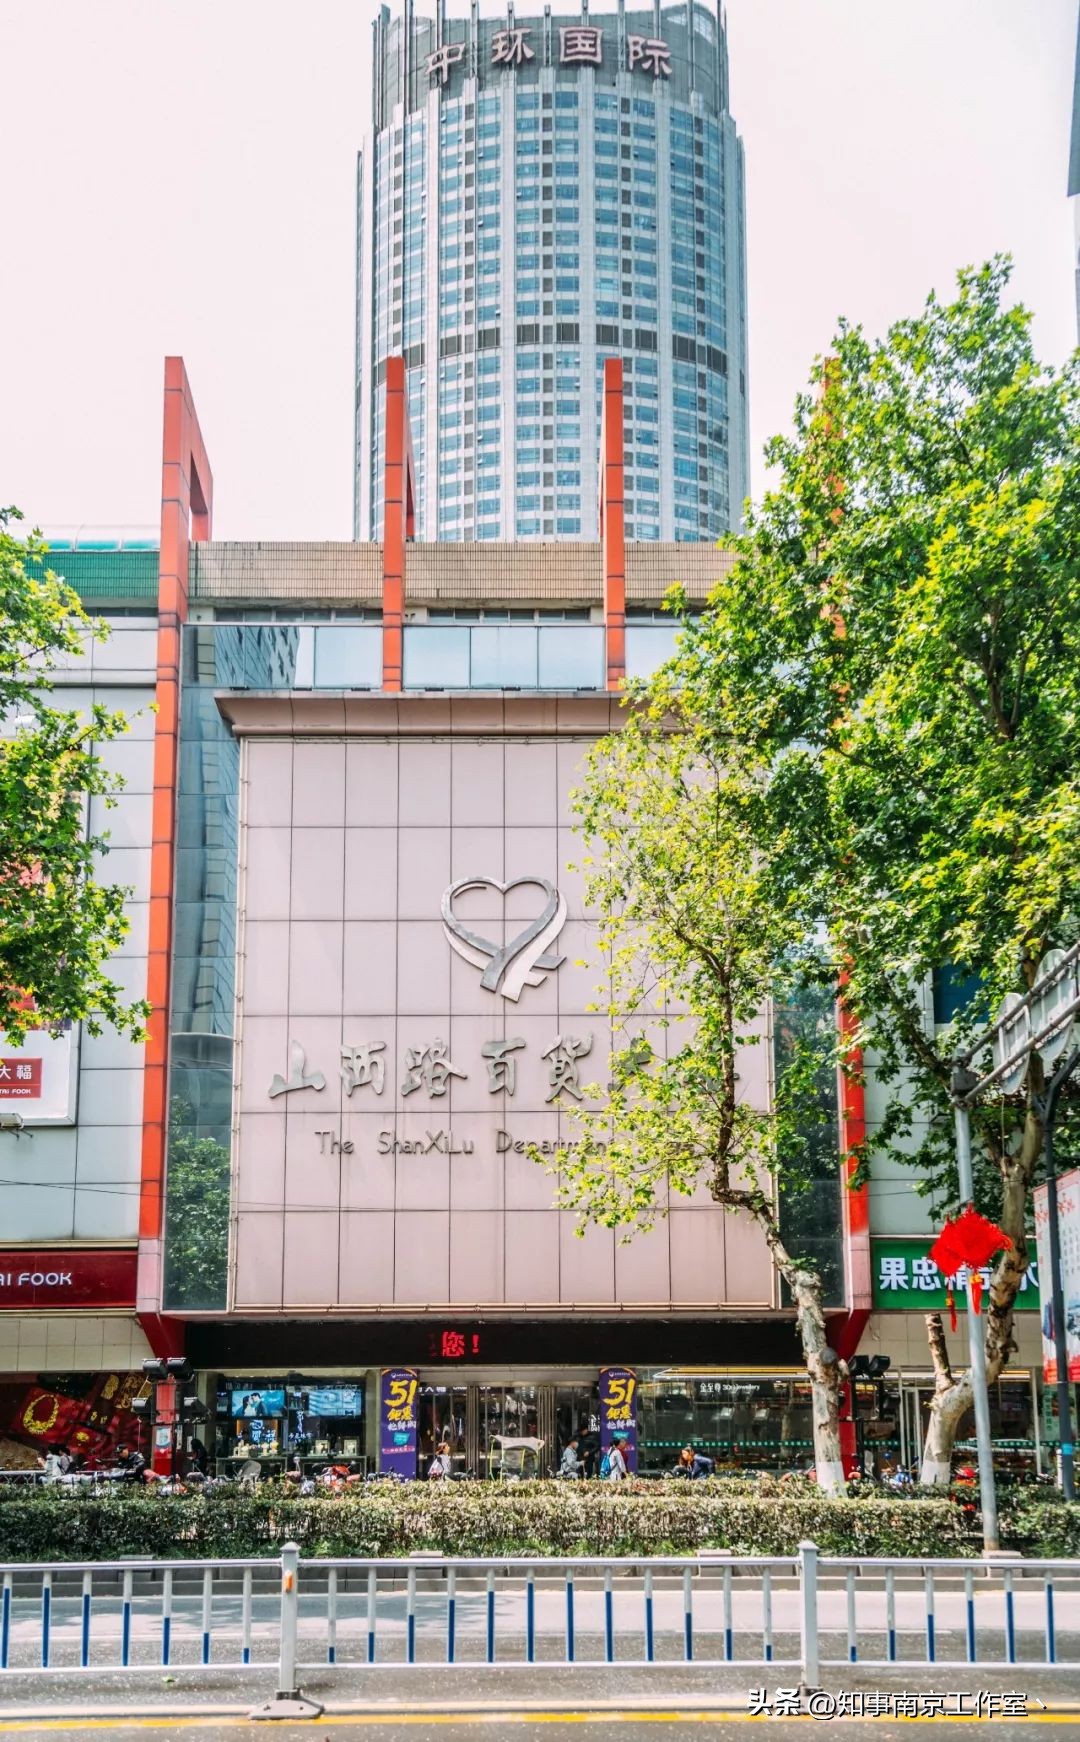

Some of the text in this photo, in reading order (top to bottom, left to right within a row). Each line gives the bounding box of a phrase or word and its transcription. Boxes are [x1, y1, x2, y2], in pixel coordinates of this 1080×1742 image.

[424, 25, 673, 83] 中环国际
[314, 1130, 354, 1154] The
[377, 1130, 475, 1154] ShanXiLu
[18, 1272, 72, 1286] FOOK
[383, 1379, 418, 1407] 51
[602, 1378, 636, 1406] 51
